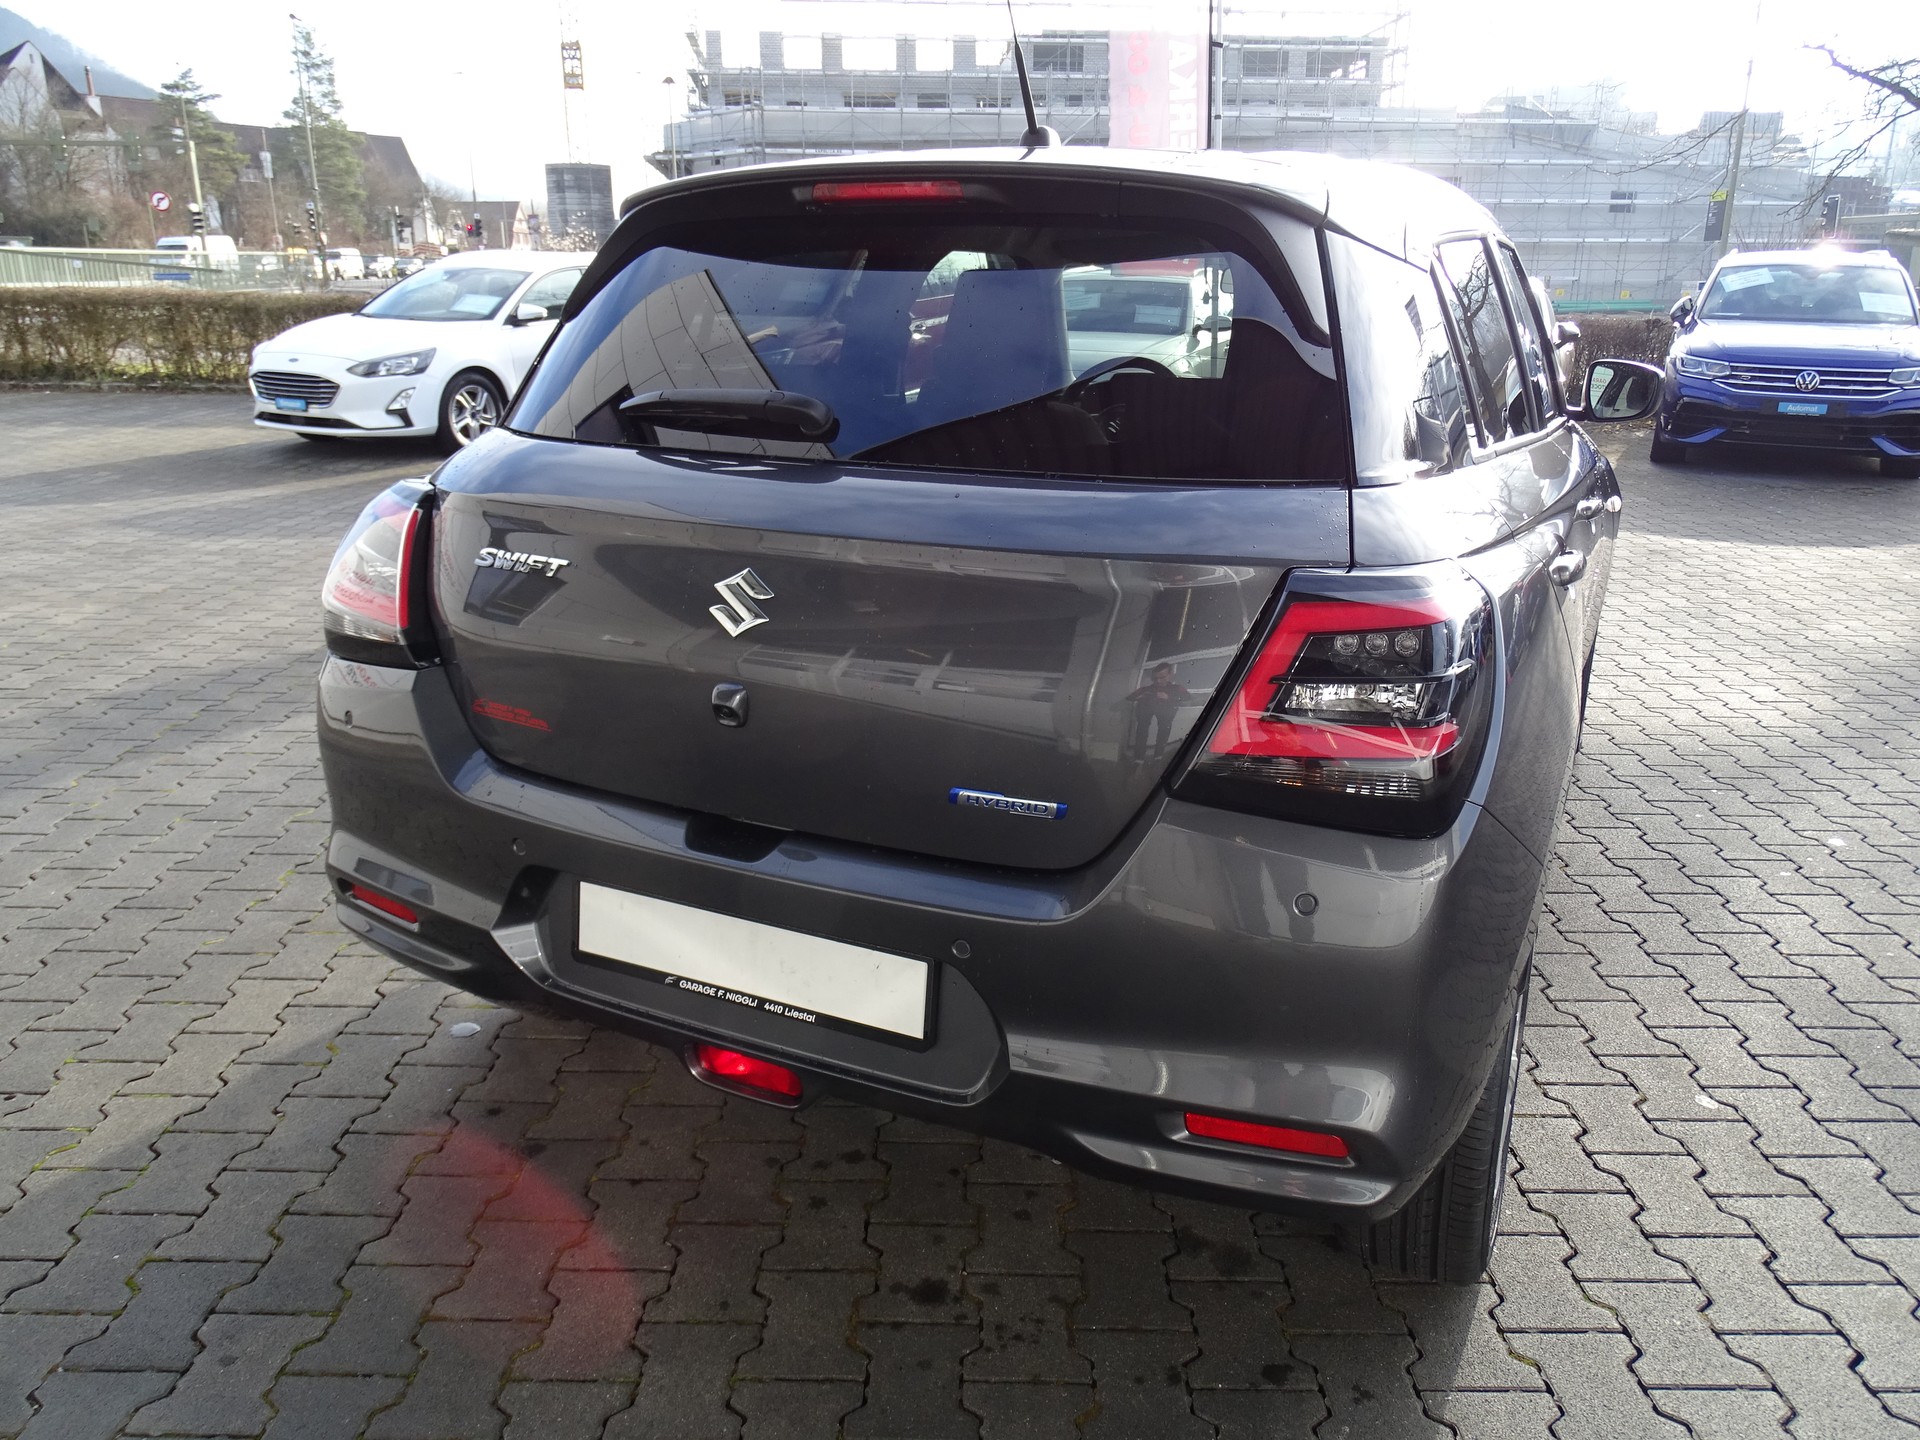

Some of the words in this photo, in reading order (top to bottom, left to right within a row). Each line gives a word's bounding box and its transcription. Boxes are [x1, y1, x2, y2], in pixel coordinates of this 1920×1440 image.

[1787, 404, 1818, 412] Automat
[474, 547, 571, 577] SWIFT
[966, 795, 1049, 814] HYBRID
[679, 979, 716, 997] GARAGE
[717, 989, 725, 999] F.
[725, 991, 758, 1008] NIGGLI
[763, 1001, 783, 1014] 4410
[784, 1007, 816, 1023] Liestal
